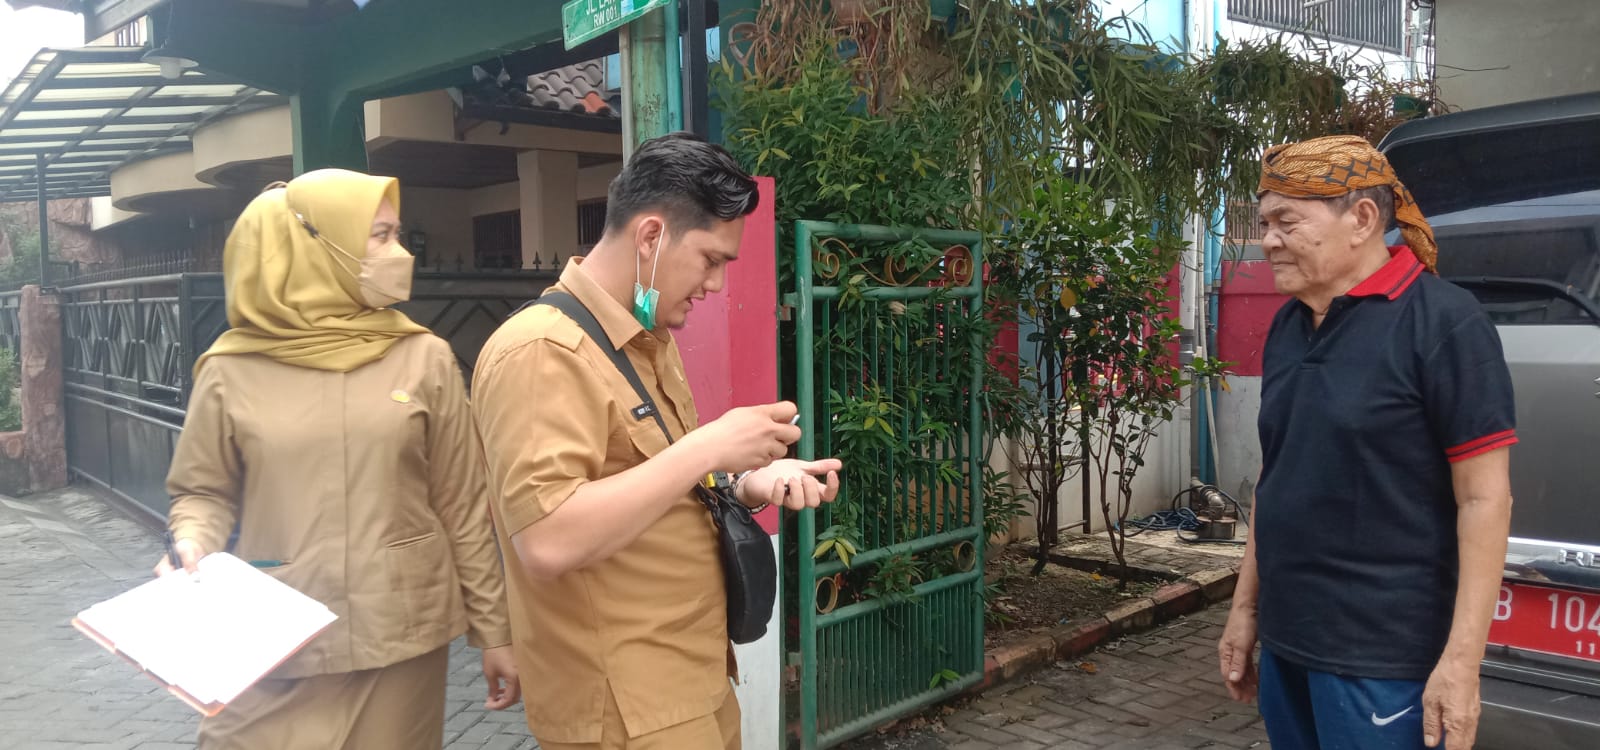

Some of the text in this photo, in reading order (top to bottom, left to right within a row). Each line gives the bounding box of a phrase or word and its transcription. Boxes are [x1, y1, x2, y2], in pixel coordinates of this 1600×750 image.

[594, 6, 617, 28] RW 001
[1493, 586, 1600, 636] B 104
